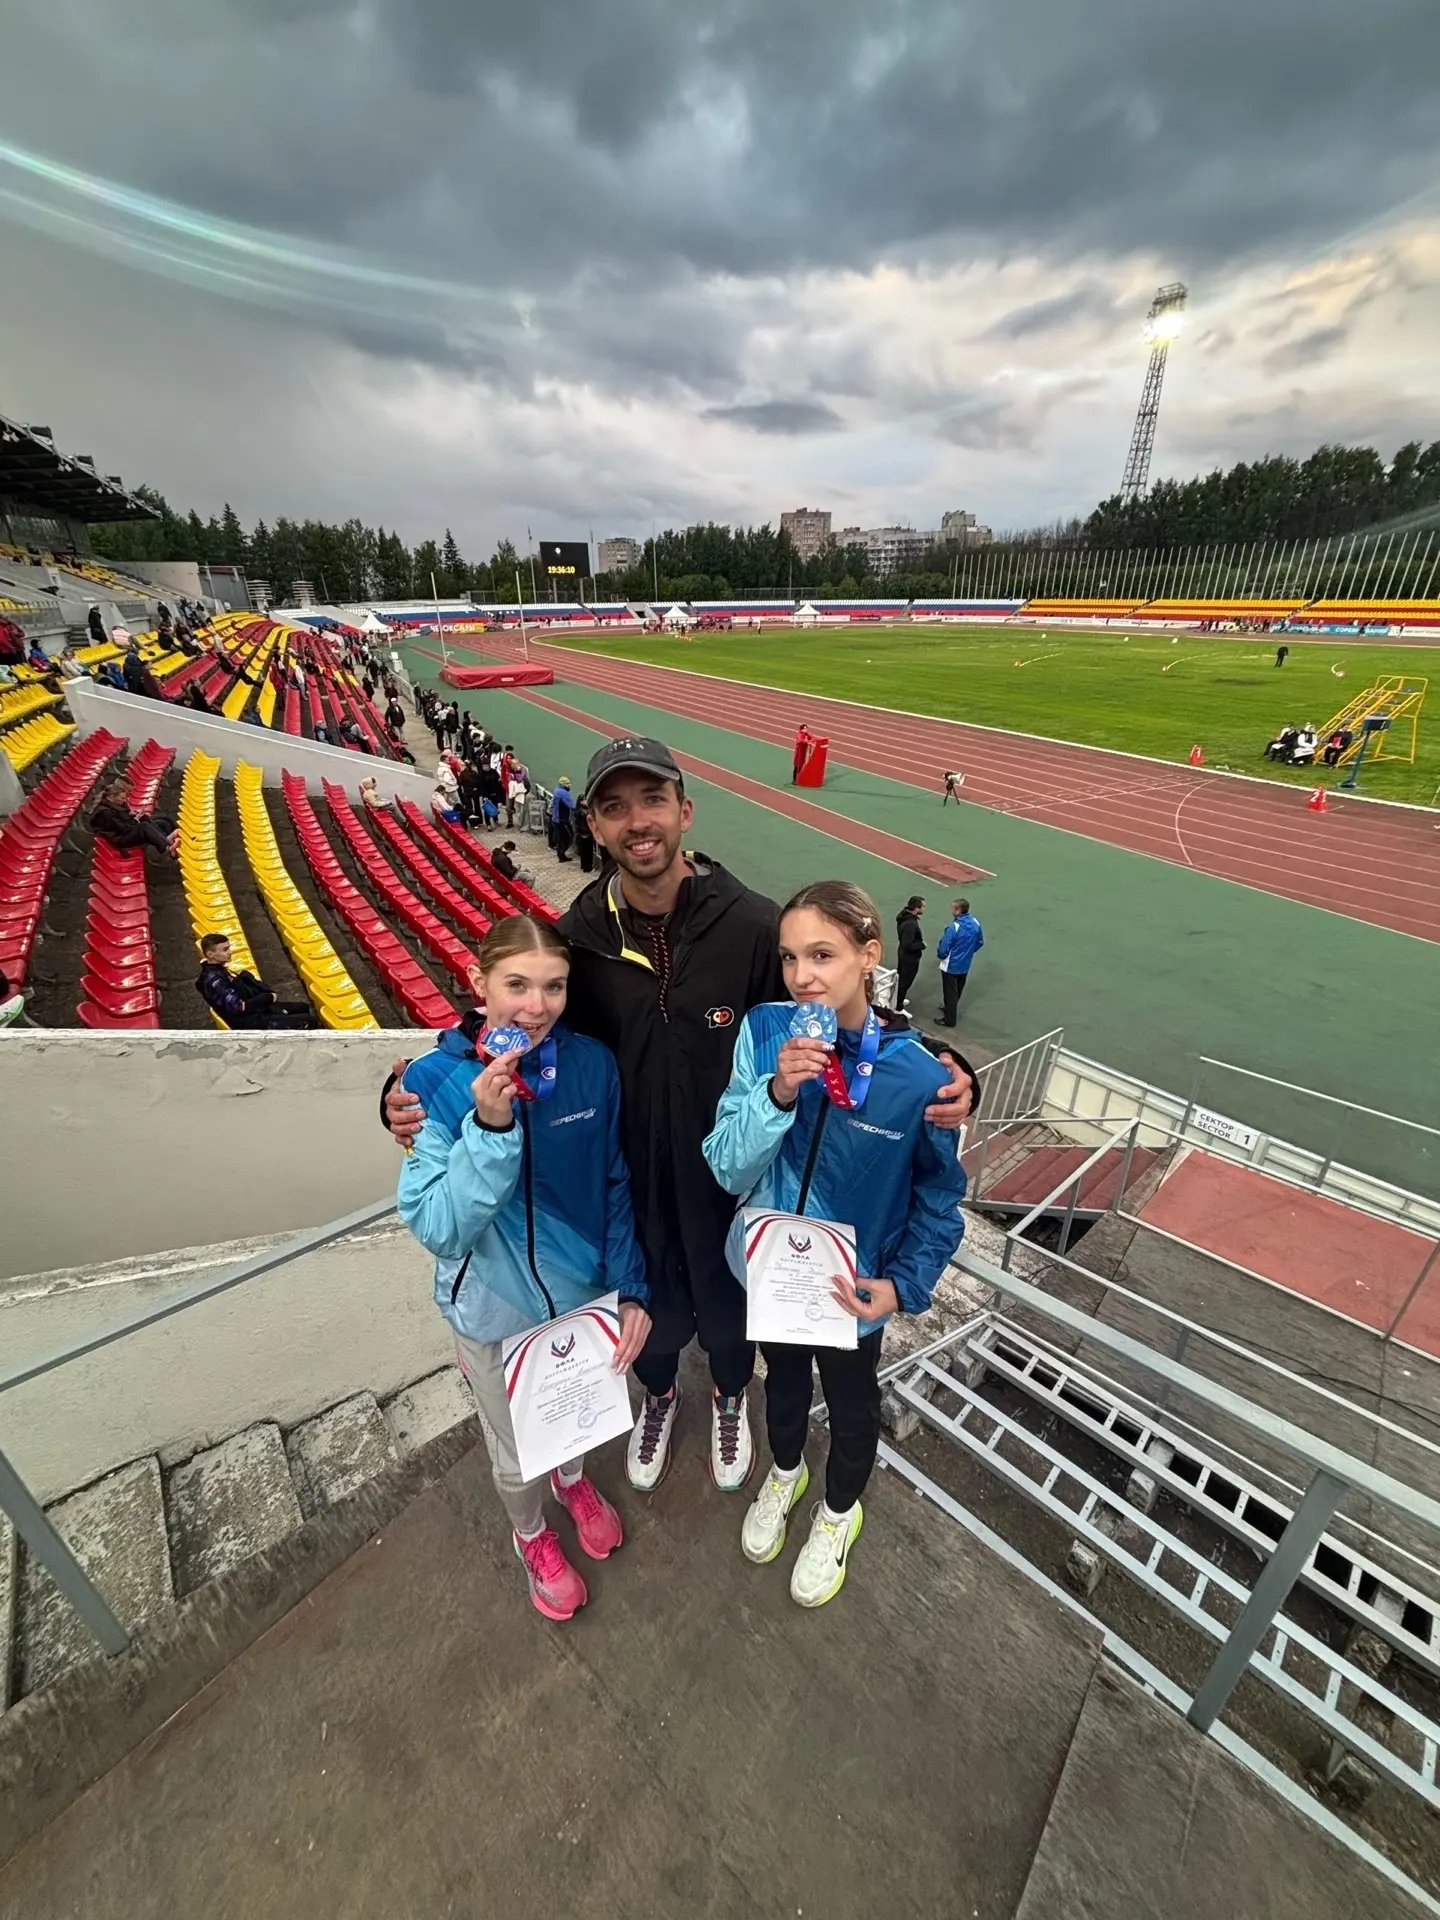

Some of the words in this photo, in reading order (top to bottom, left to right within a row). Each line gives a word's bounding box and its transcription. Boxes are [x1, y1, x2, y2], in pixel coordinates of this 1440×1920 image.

[1200, 1113, 1234, 1131] СЕКТОР
[1197, 1121, 1231, 1139] SECTOR
[1244, 1134, 1251, 1145] 1
